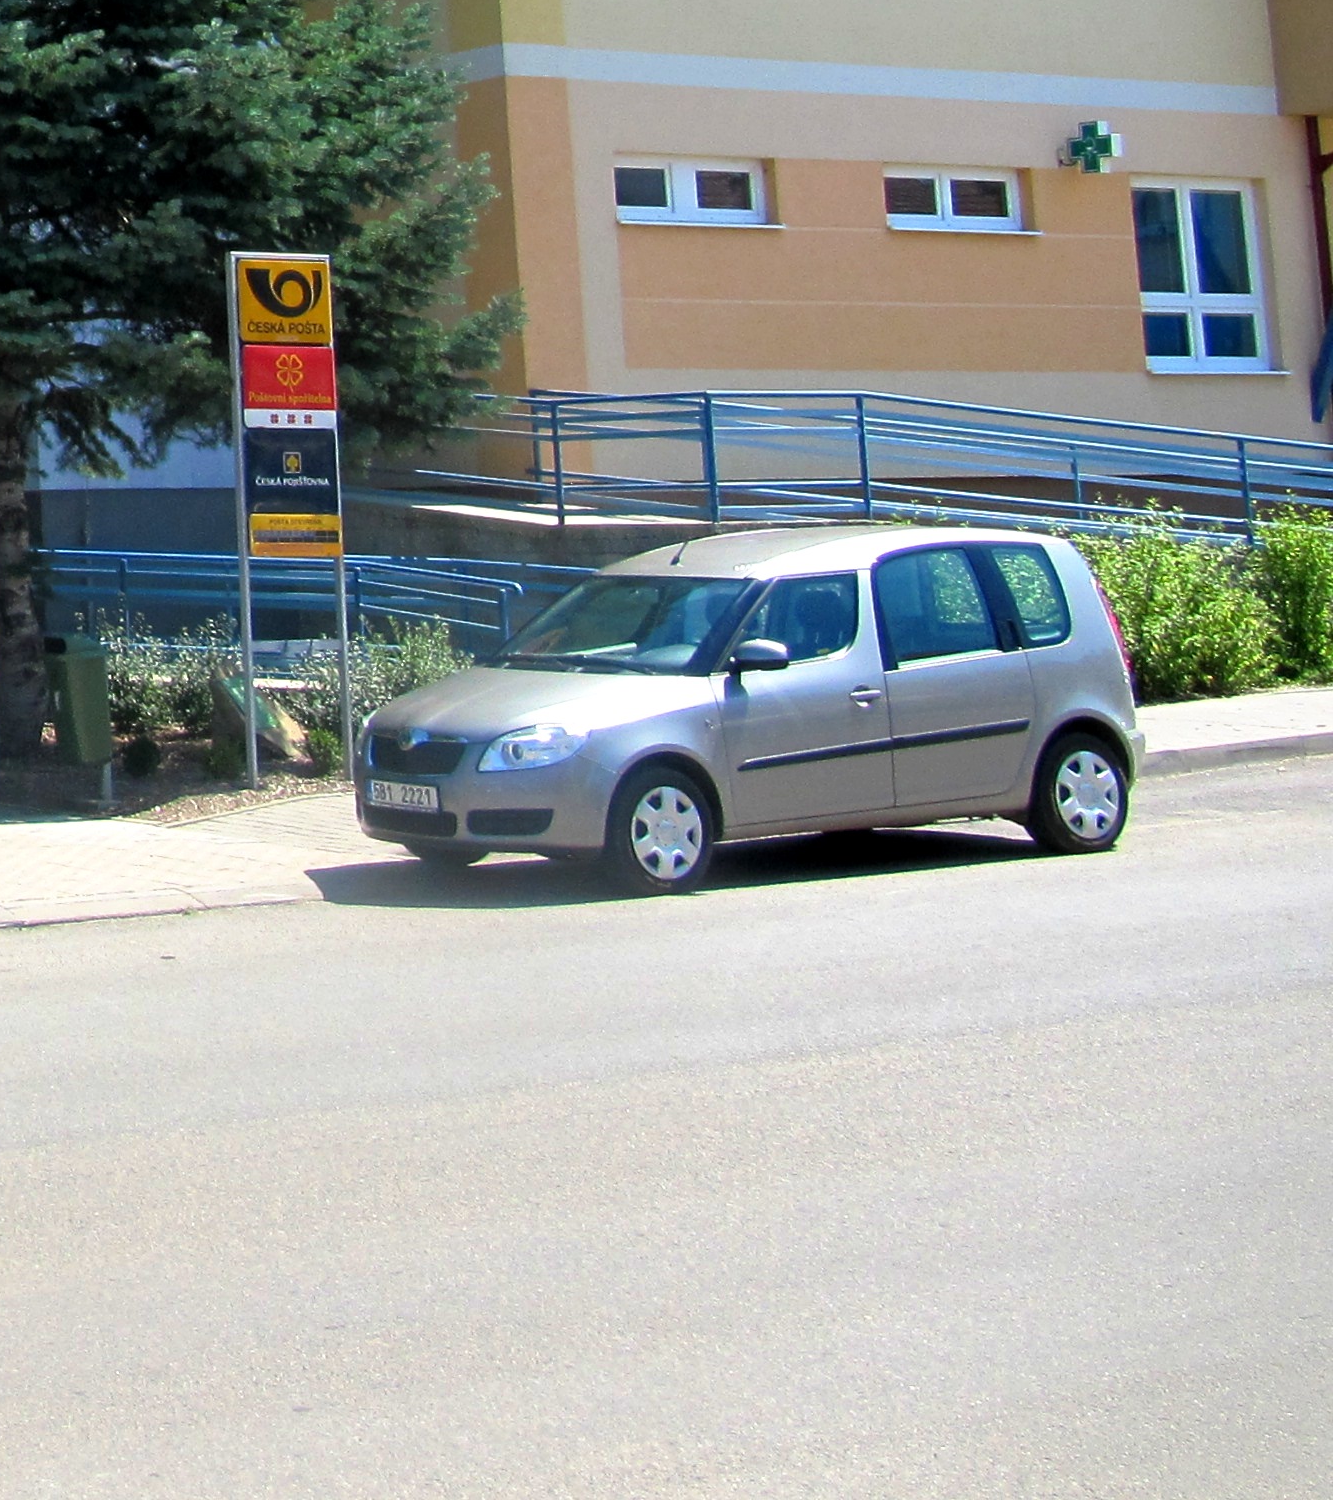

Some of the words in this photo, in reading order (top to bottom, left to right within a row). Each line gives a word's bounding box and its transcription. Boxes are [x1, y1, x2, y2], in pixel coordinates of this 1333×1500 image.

[247, 319, 285, 334] ČESKÁ
[289, 320, 326, 334] POŠTA
[400, 785, 431, 806] 2221
